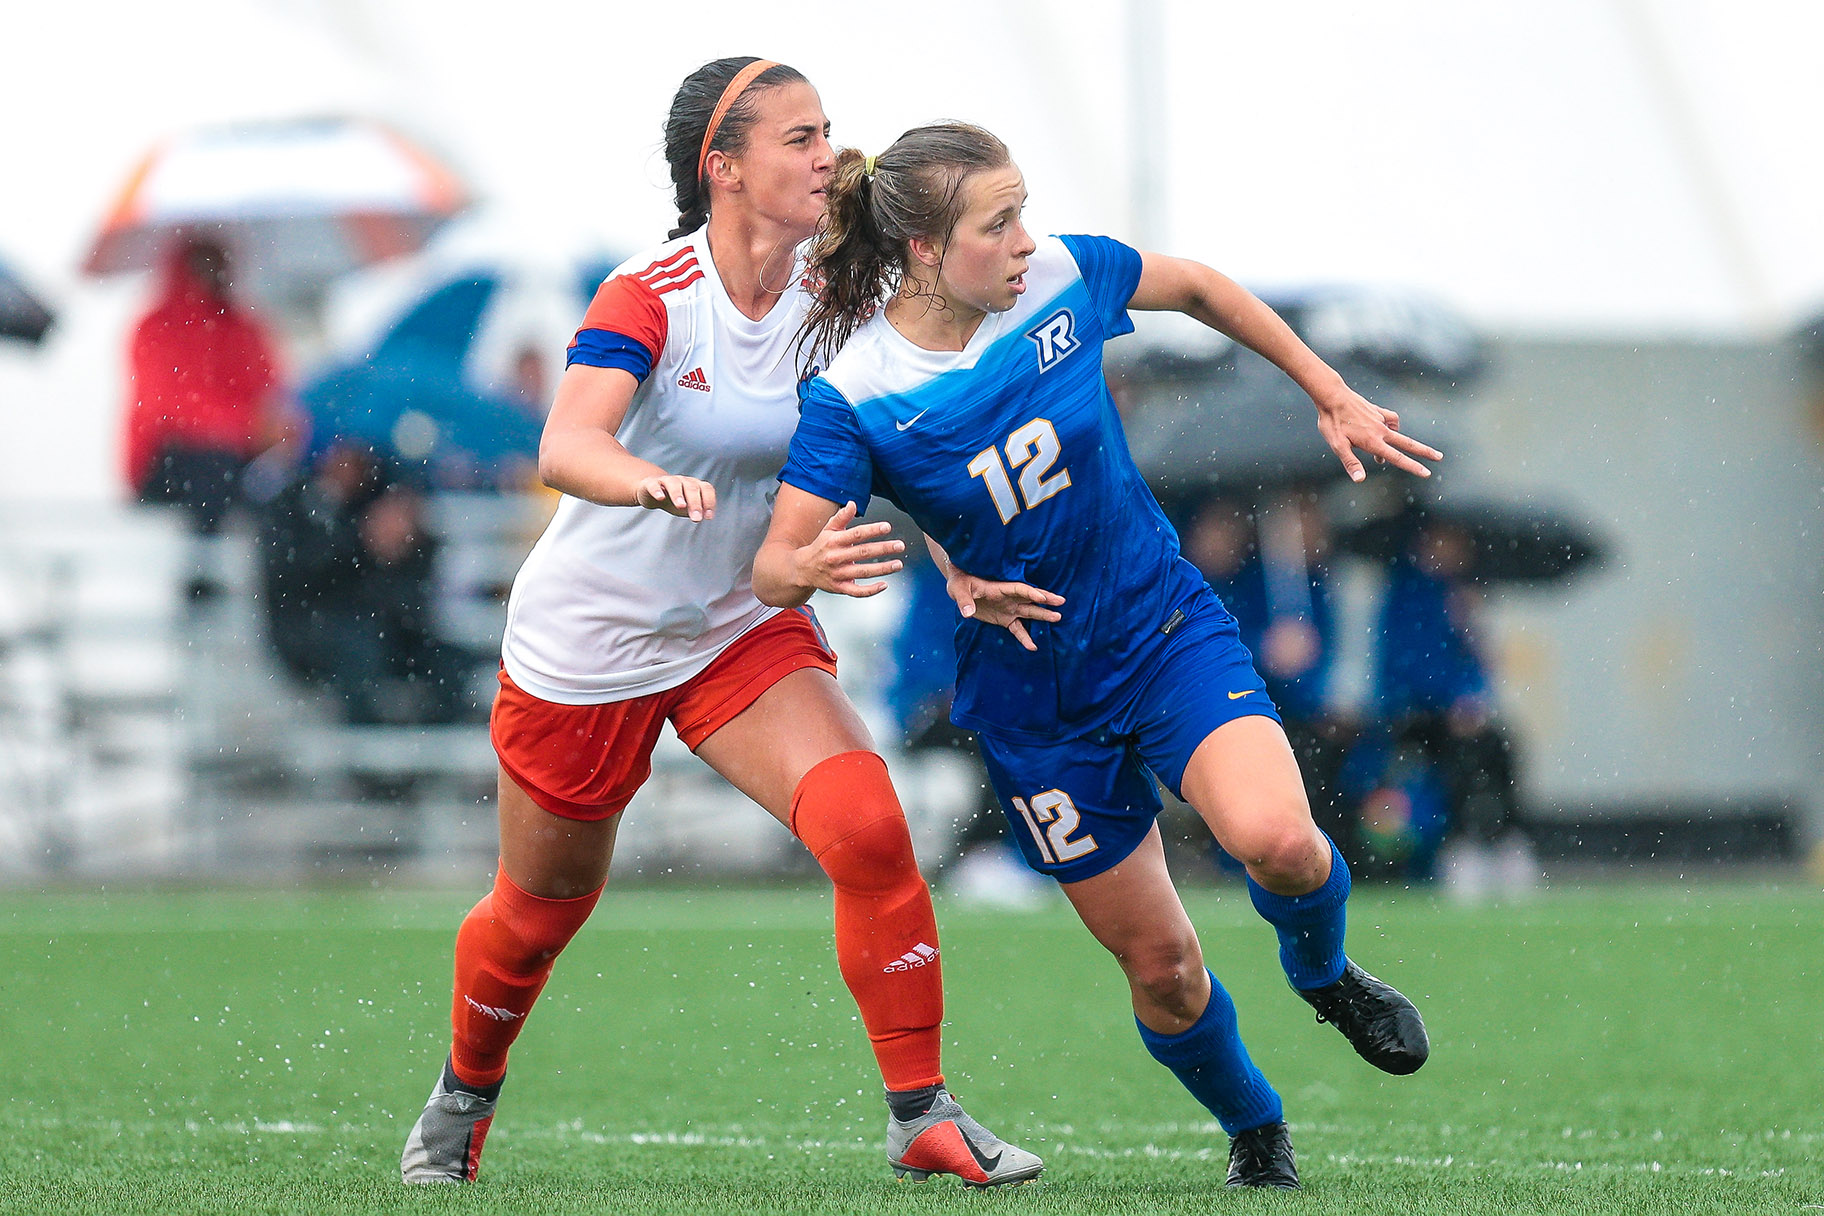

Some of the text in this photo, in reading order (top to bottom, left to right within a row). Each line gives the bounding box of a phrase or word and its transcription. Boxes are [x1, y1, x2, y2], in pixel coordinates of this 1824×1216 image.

[1027, 309, 1079, 370] R
[677, 379, 711, 392] adidas
[967, 417, 1072, 526] 12
[1011, 788, 1099, 864] 12
